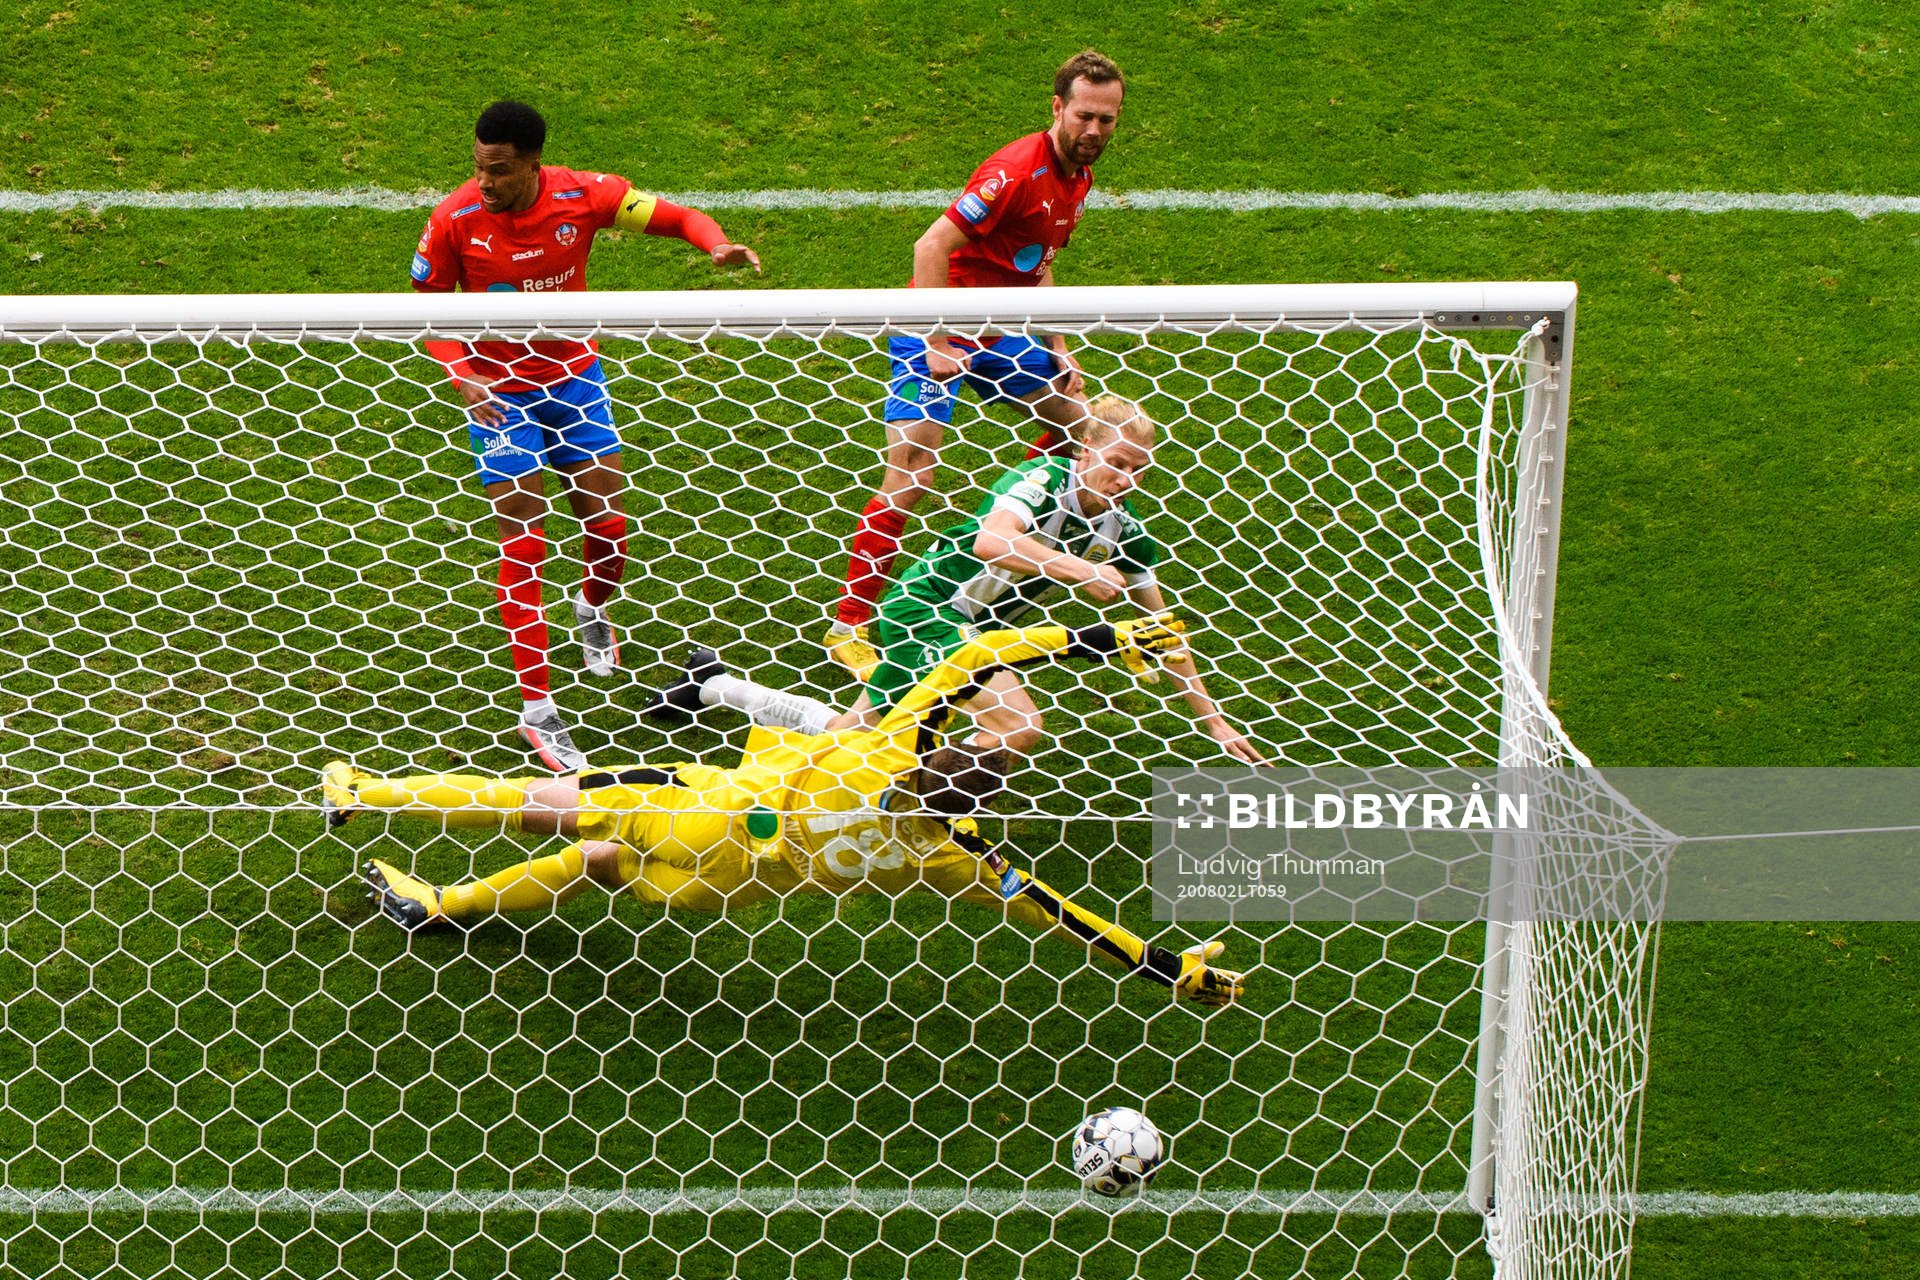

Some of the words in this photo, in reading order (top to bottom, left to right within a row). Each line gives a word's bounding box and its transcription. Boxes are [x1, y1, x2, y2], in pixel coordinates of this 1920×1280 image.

[511, 248, 545, 262] stadium
[522, 265, 576, 292] Resurs
[806, 797, 906, 878] 18
